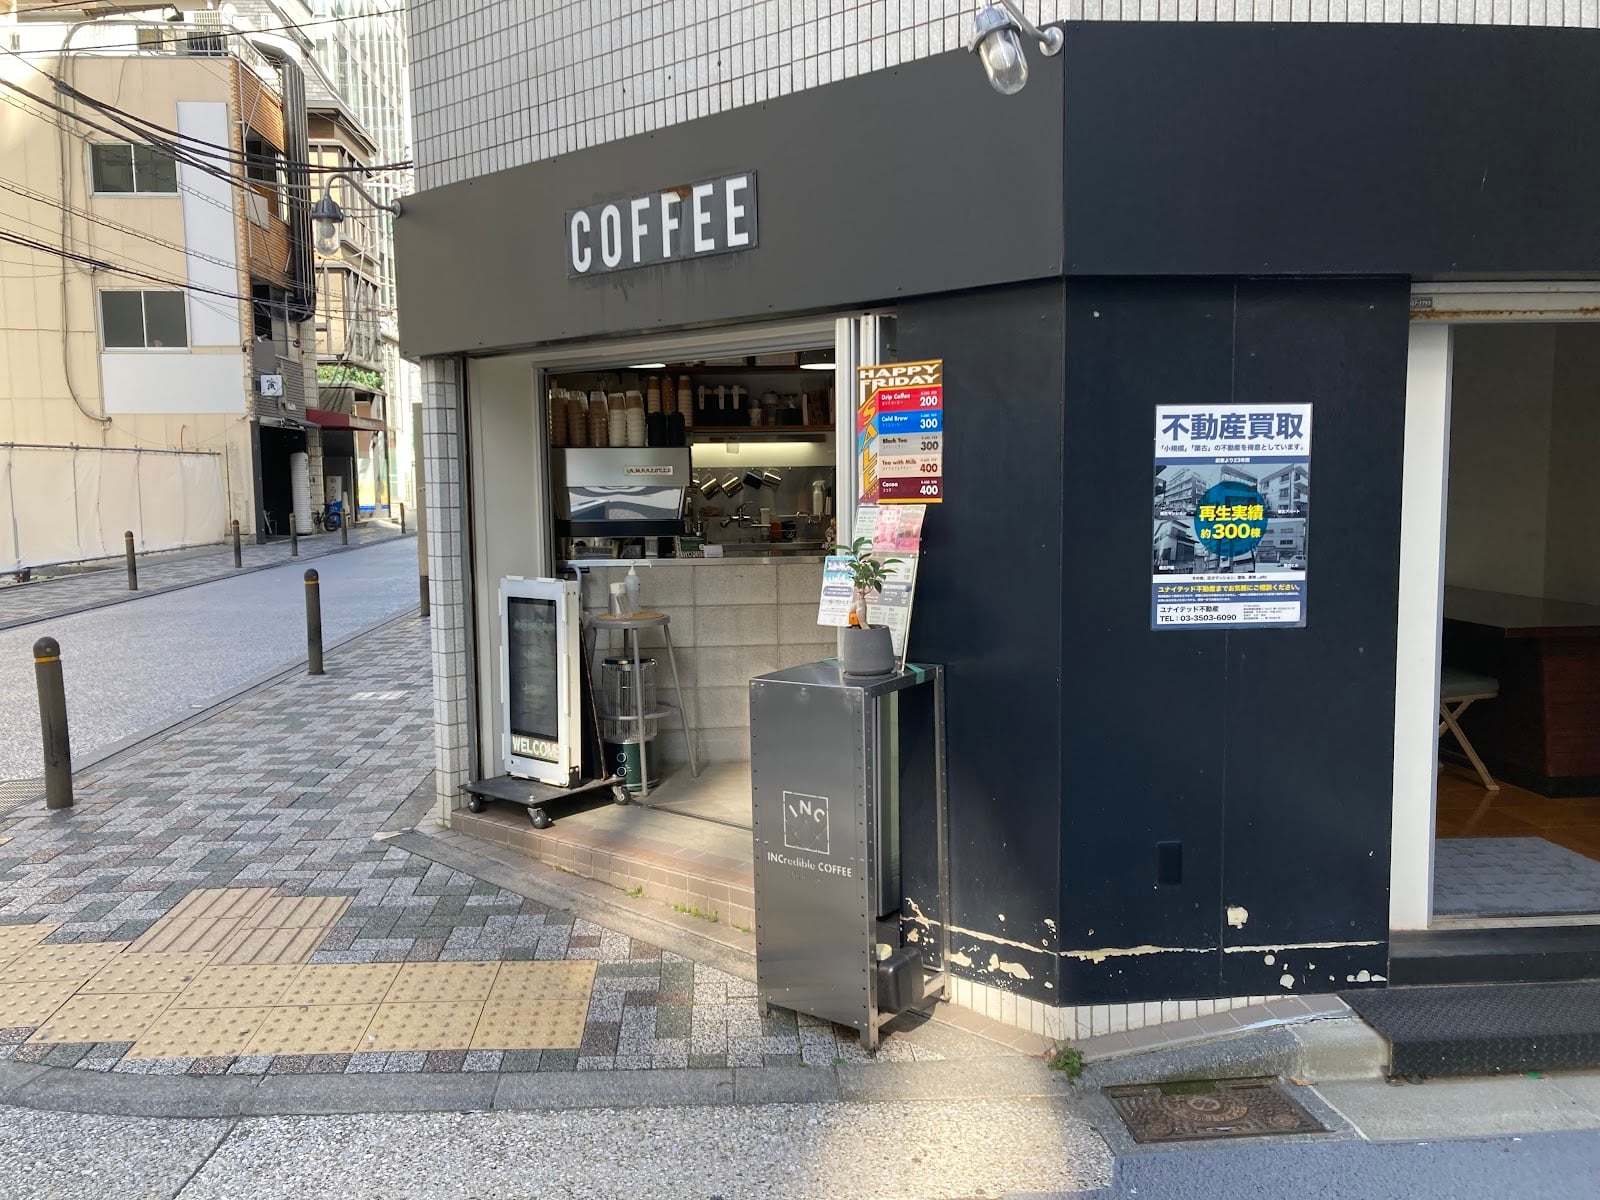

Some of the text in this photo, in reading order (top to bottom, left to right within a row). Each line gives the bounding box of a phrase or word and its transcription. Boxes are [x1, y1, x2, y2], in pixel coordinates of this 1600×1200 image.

[571, 176, 749, 273] COFFEE
[860, 363, 940, 379] HAPPY
[860, 373, 940, 406] FRIDAY
[894, 392, 911, 400] Coffee
[920, 396, 938, 407] 200
[920, 418, 938, 429] 300
[1162, 412, 1304, 441] 不動産買取
[863, 400, 878, 492] SALE
[920, 441, 939, 451] 300
[920, 463, 938, 473] 400
[920, 485, 938, 496] 400
[1199, 504, 1264, 521] 再生実績
[1201, 523, 1261, 540] 約300棟
[1160, 605, 1219, 613] ユナイテッド不動産
[789, 799, 826, 823] INC
[767, 851, 816, 870] INCredible
[818, 862, 852, 878] COFFEE
